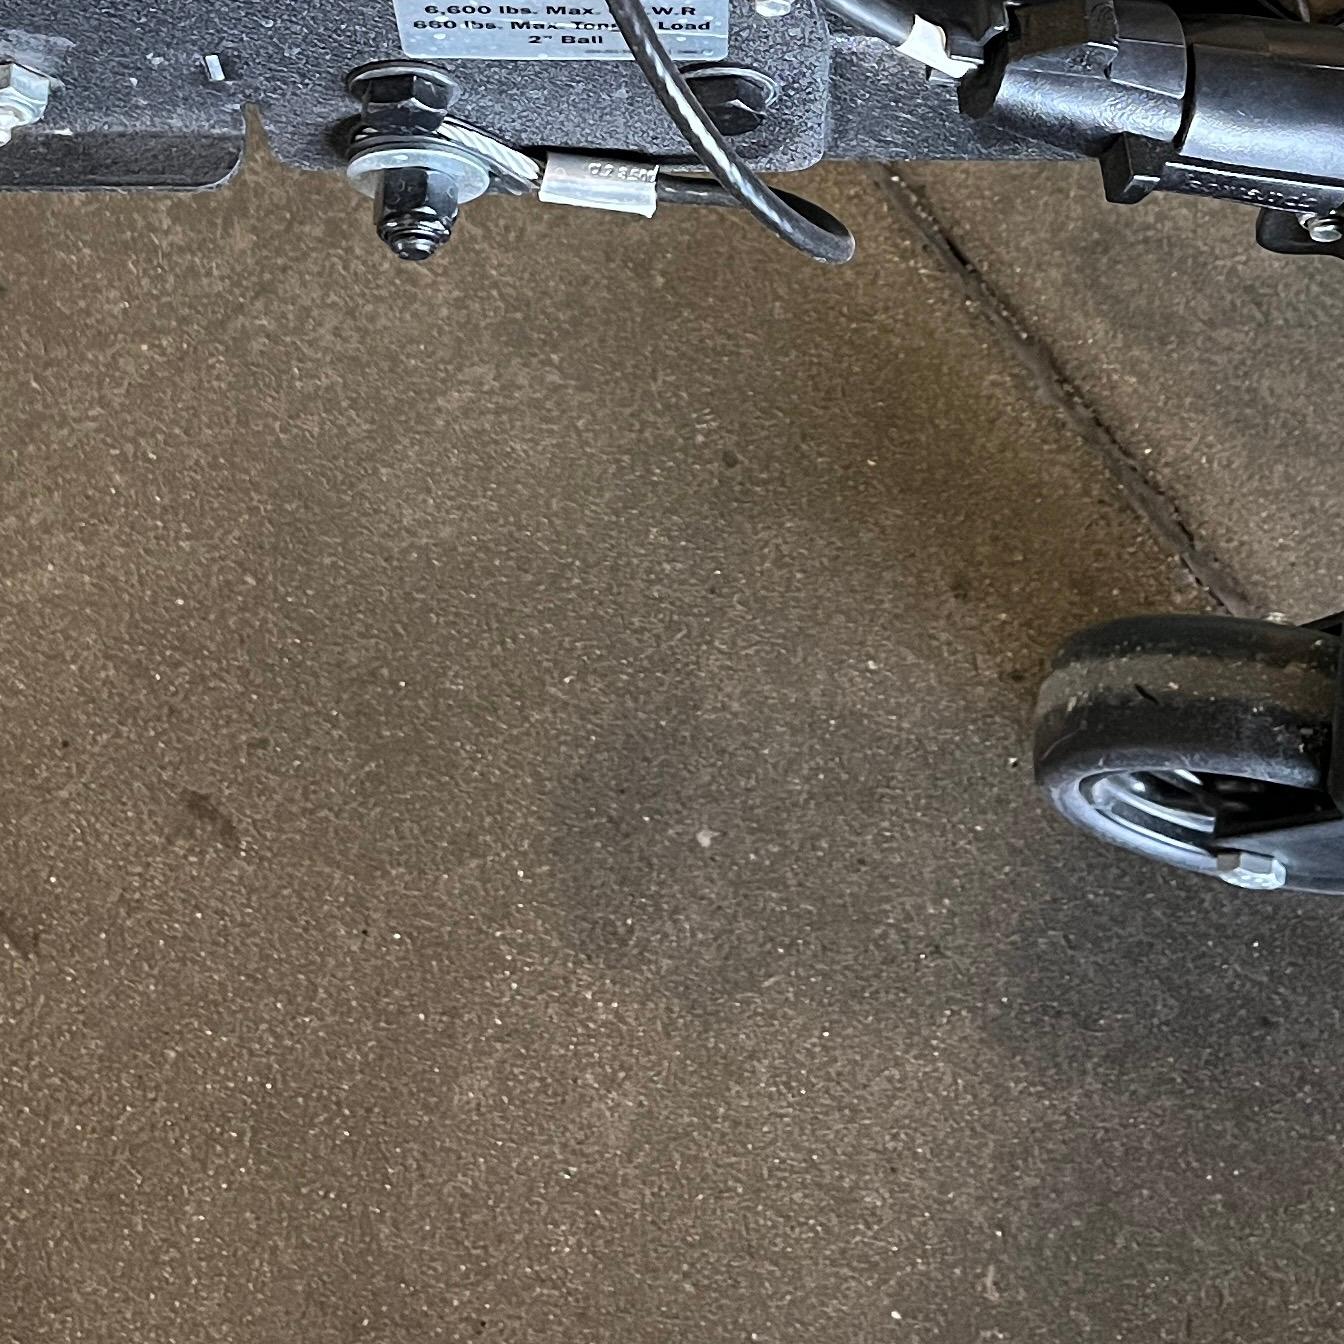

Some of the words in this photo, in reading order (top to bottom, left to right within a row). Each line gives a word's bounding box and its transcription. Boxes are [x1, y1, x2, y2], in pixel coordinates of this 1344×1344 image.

[424, 5, 492, 16] 6,600
[499, 5, 538, 15] lbs.
[546, 5, 601, 16] Max.
[413, 20, 457, 30] 660
[464, 20, 503, 30] lbs.
[658, 21, 710, 31] Load
[528, 35, 552, 44] 2"
[561, 35, 603, 44] Ball
